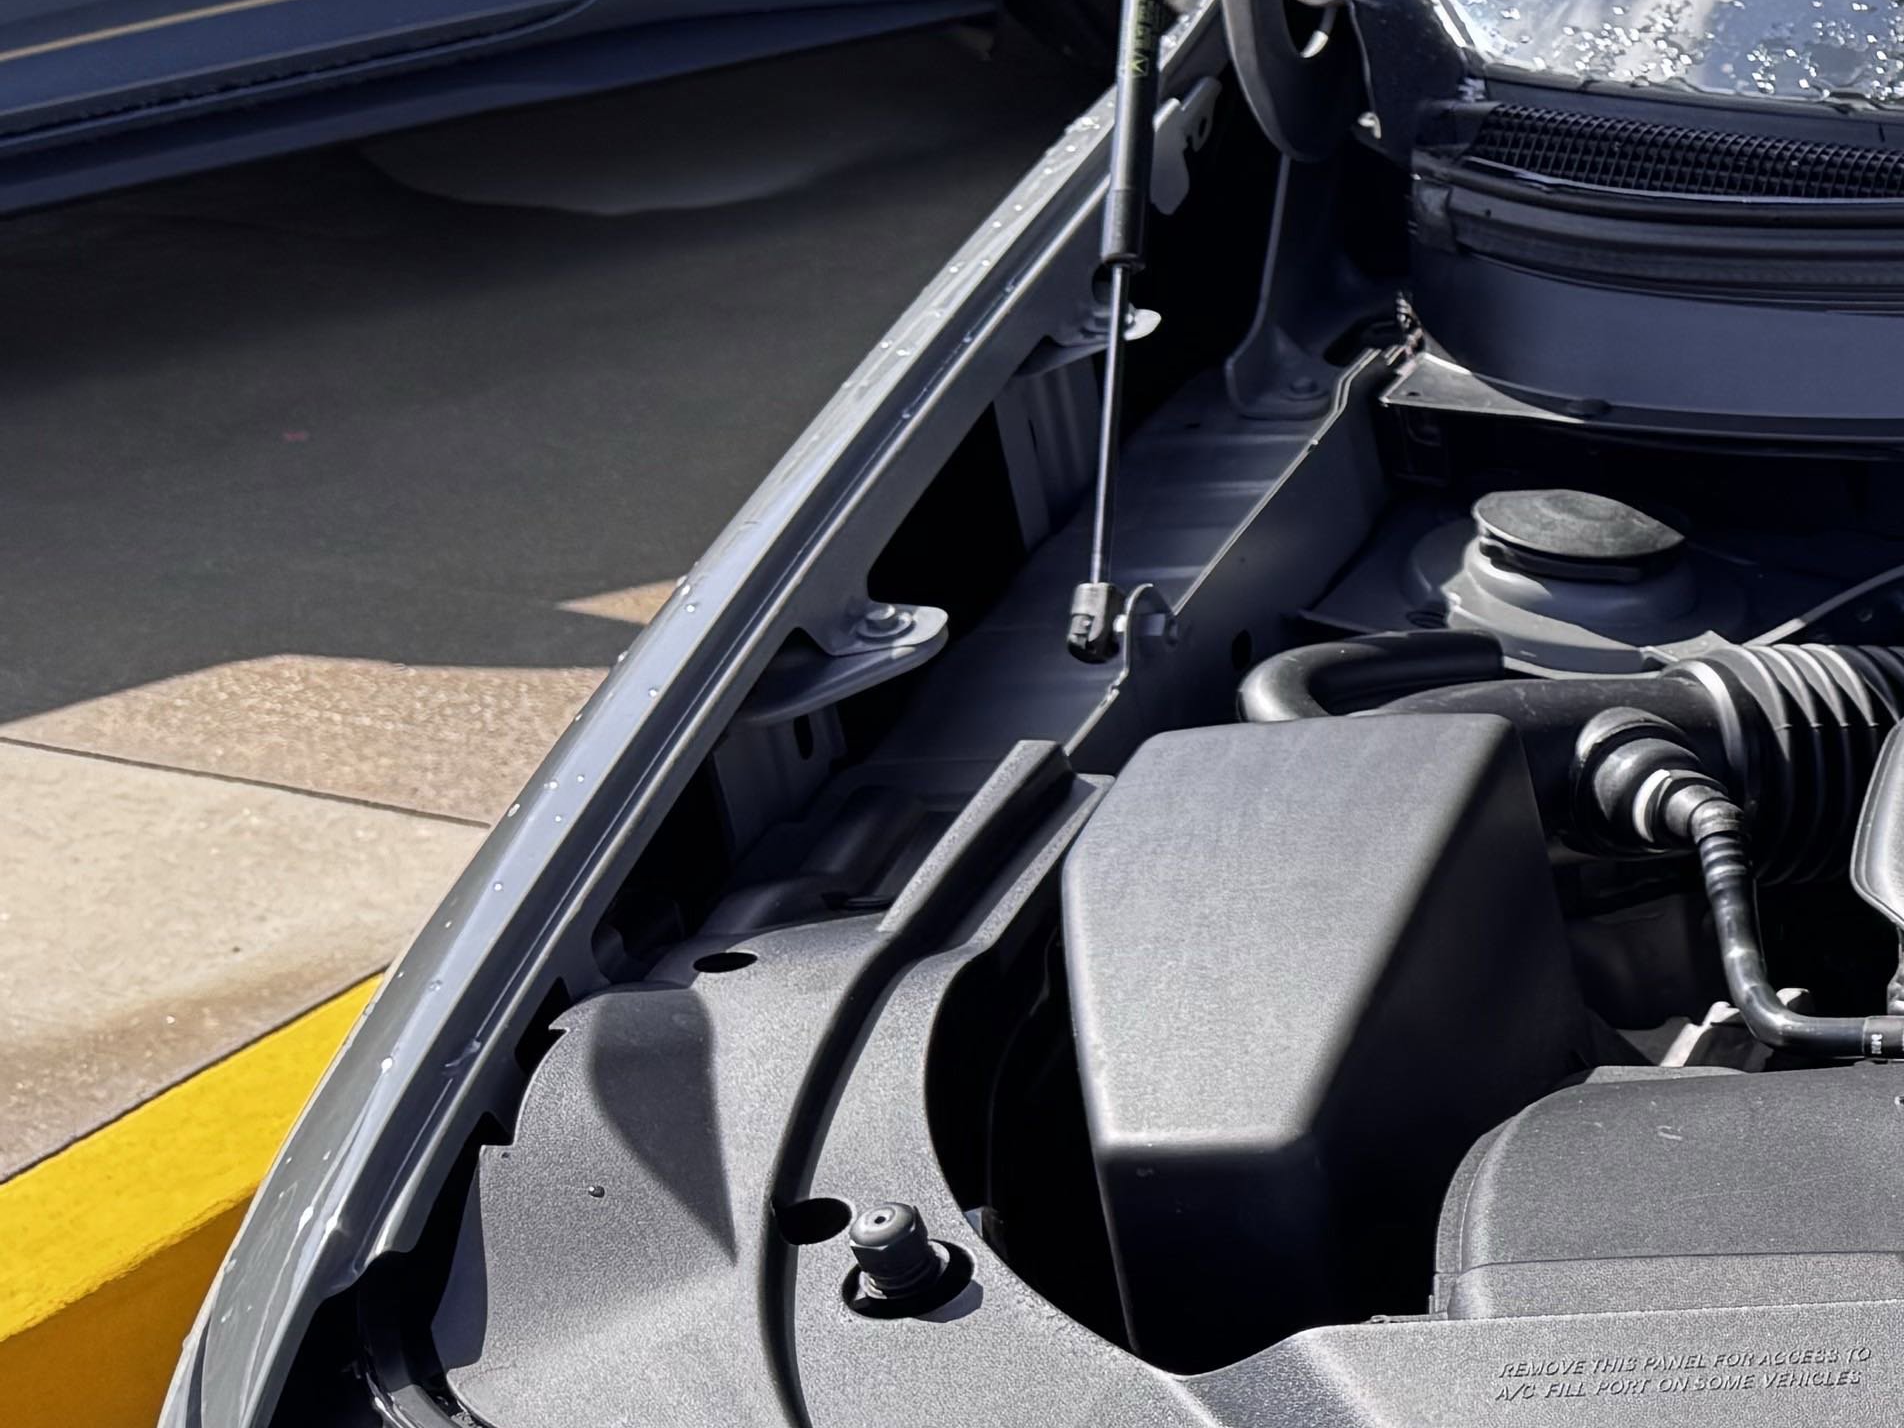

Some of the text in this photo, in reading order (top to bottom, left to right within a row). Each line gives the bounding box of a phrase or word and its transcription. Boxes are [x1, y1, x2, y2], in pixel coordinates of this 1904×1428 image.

[1500, 1347, 1873, 1378] REMOVE THIS PANEL FOR ACCESS TO
[1495, 1370, 1862, 1402] A/C FILL PORT ON SOME VEHICLES
